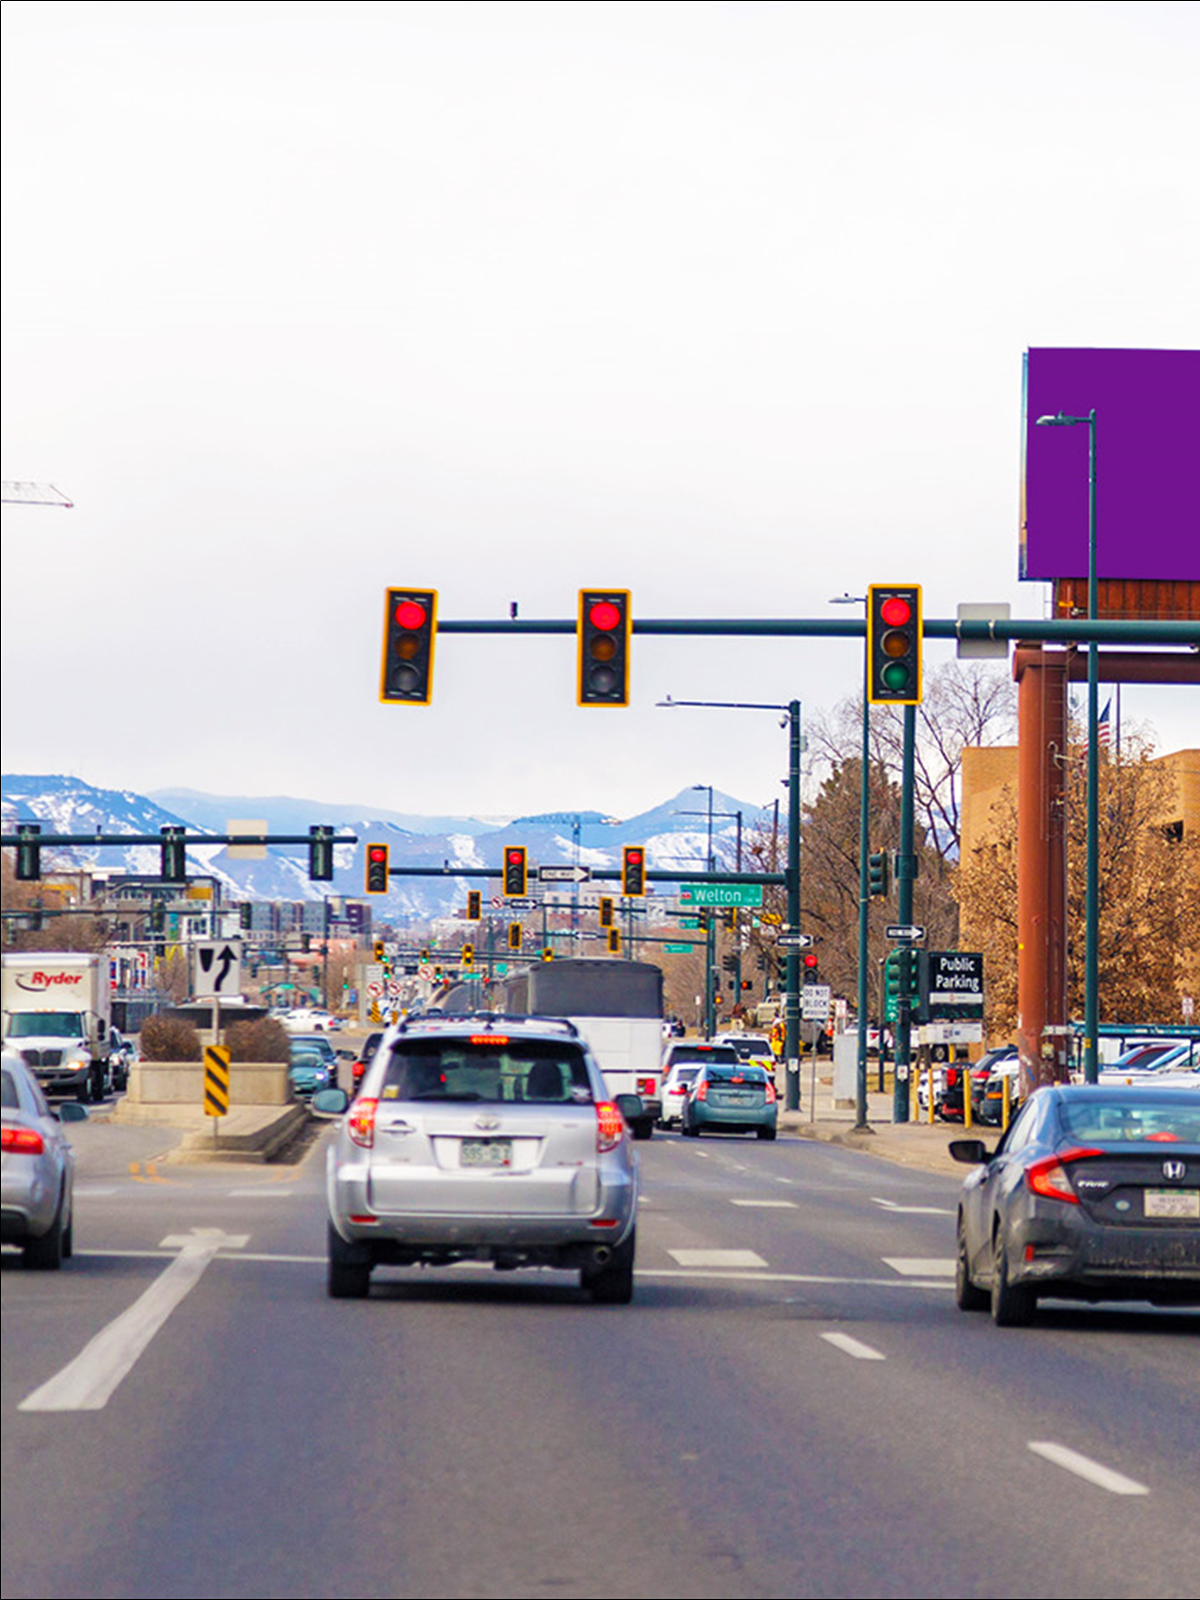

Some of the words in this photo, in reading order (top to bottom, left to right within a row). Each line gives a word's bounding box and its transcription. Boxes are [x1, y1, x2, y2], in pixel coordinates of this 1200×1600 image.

[694, 888, 742, 902] Welton
[940, 957, 975, 972] Public
[31, 971, 83, 987] Ryder
[935, 974, 980, 992] Parking
[805, 988, 814, 997] DO
[815, 988, 828, 997] NOT
[804, 1000, 828, 1008] BLOCK
